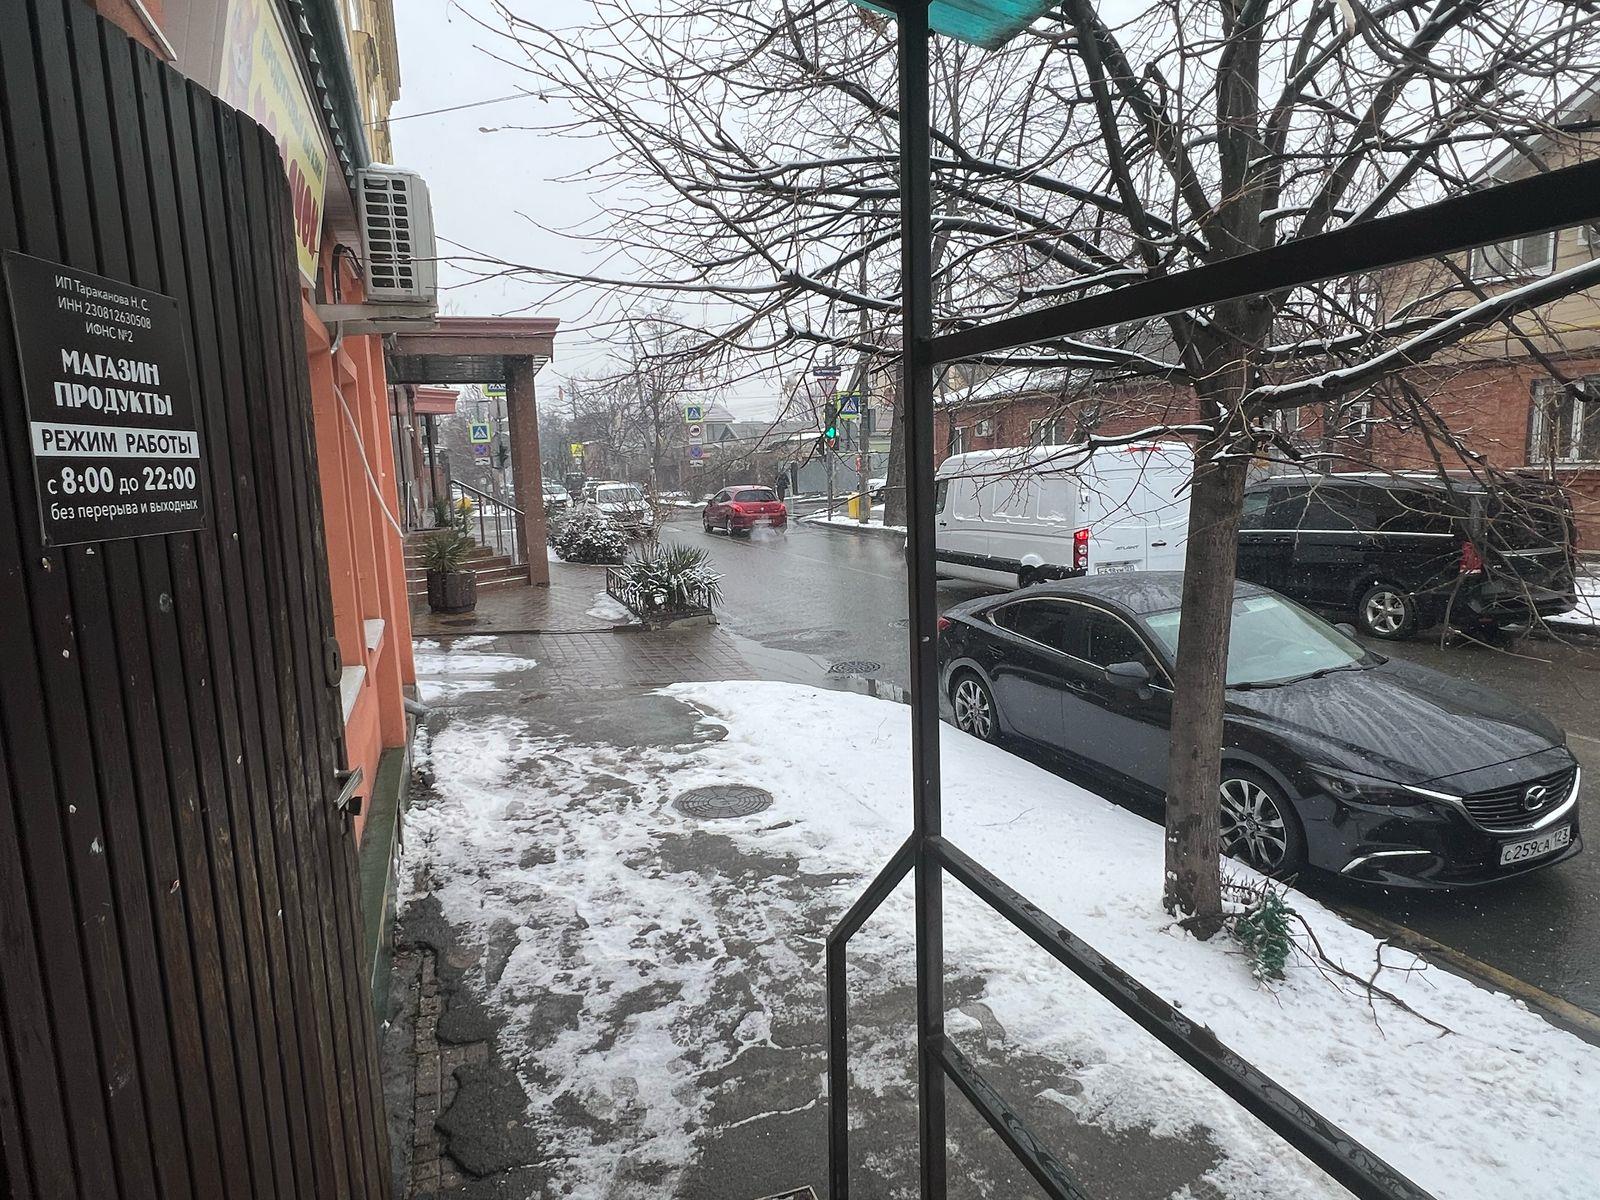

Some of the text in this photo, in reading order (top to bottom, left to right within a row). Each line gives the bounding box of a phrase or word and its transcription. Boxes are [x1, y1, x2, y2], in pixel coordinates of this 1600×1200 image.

[55, 275, 73, 290] ИП
[73, 280, 129, 306] Тараканова
[57, 296, 152, 329] ИНН 230812630508
[85, 321, 134, 343] ИФНС №2
[61, 348, 161, 386] МАГАЗИН
[53, 381, 173, 416] ПРОДУКТЫ
[41, 428, 192, 454] РЕЖИМ РАБОТЫ
[47, 466, 196, 495] с 8:00 до 22:00
[50, 499, 199, 521] без перерыва и выходных
[1504, 829, 1568, 861] С259СА 123
